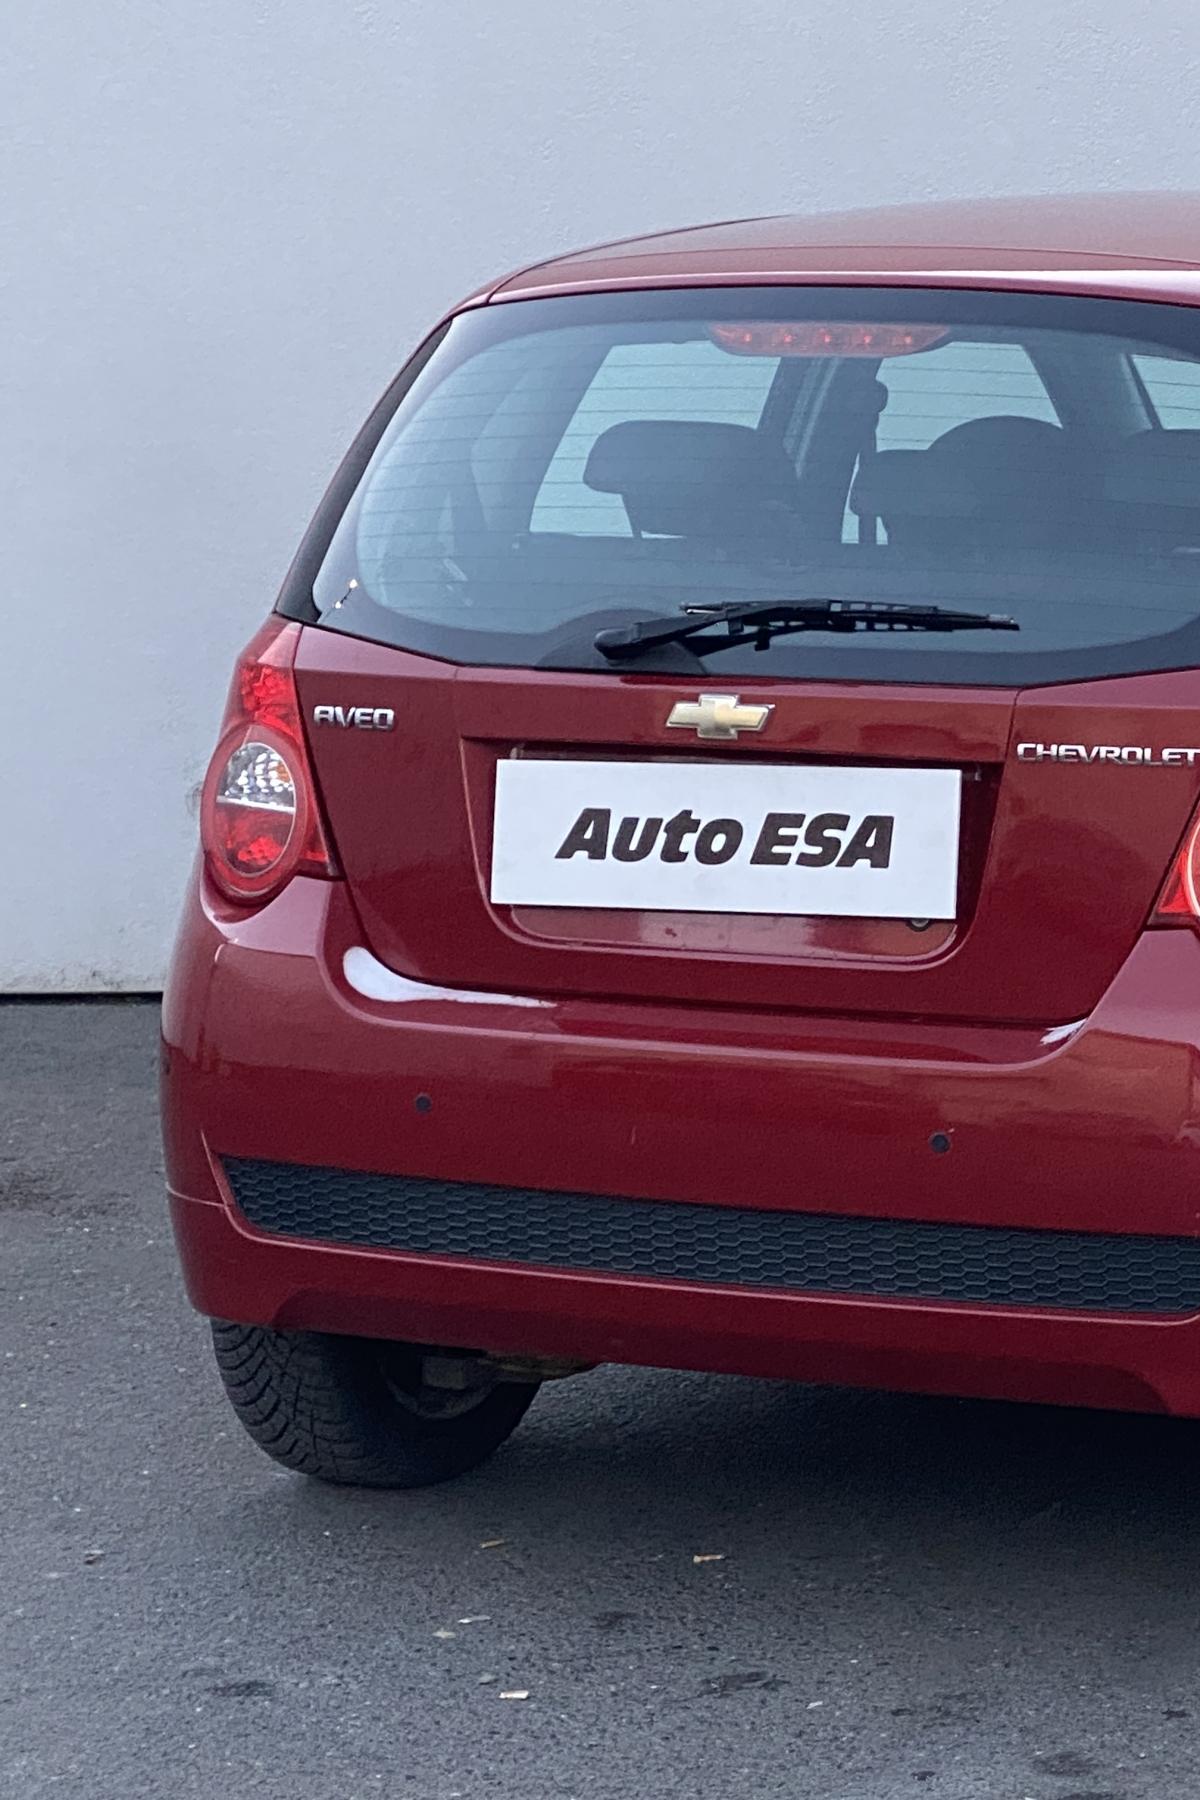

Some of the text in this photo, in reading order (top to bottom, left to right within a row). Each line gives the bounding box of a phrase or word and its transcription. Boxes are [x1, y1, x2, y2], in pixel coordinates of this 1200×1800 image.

[313, 704, 395, 731] AVEO
[554, 807, 895, 869] Auto ESA
